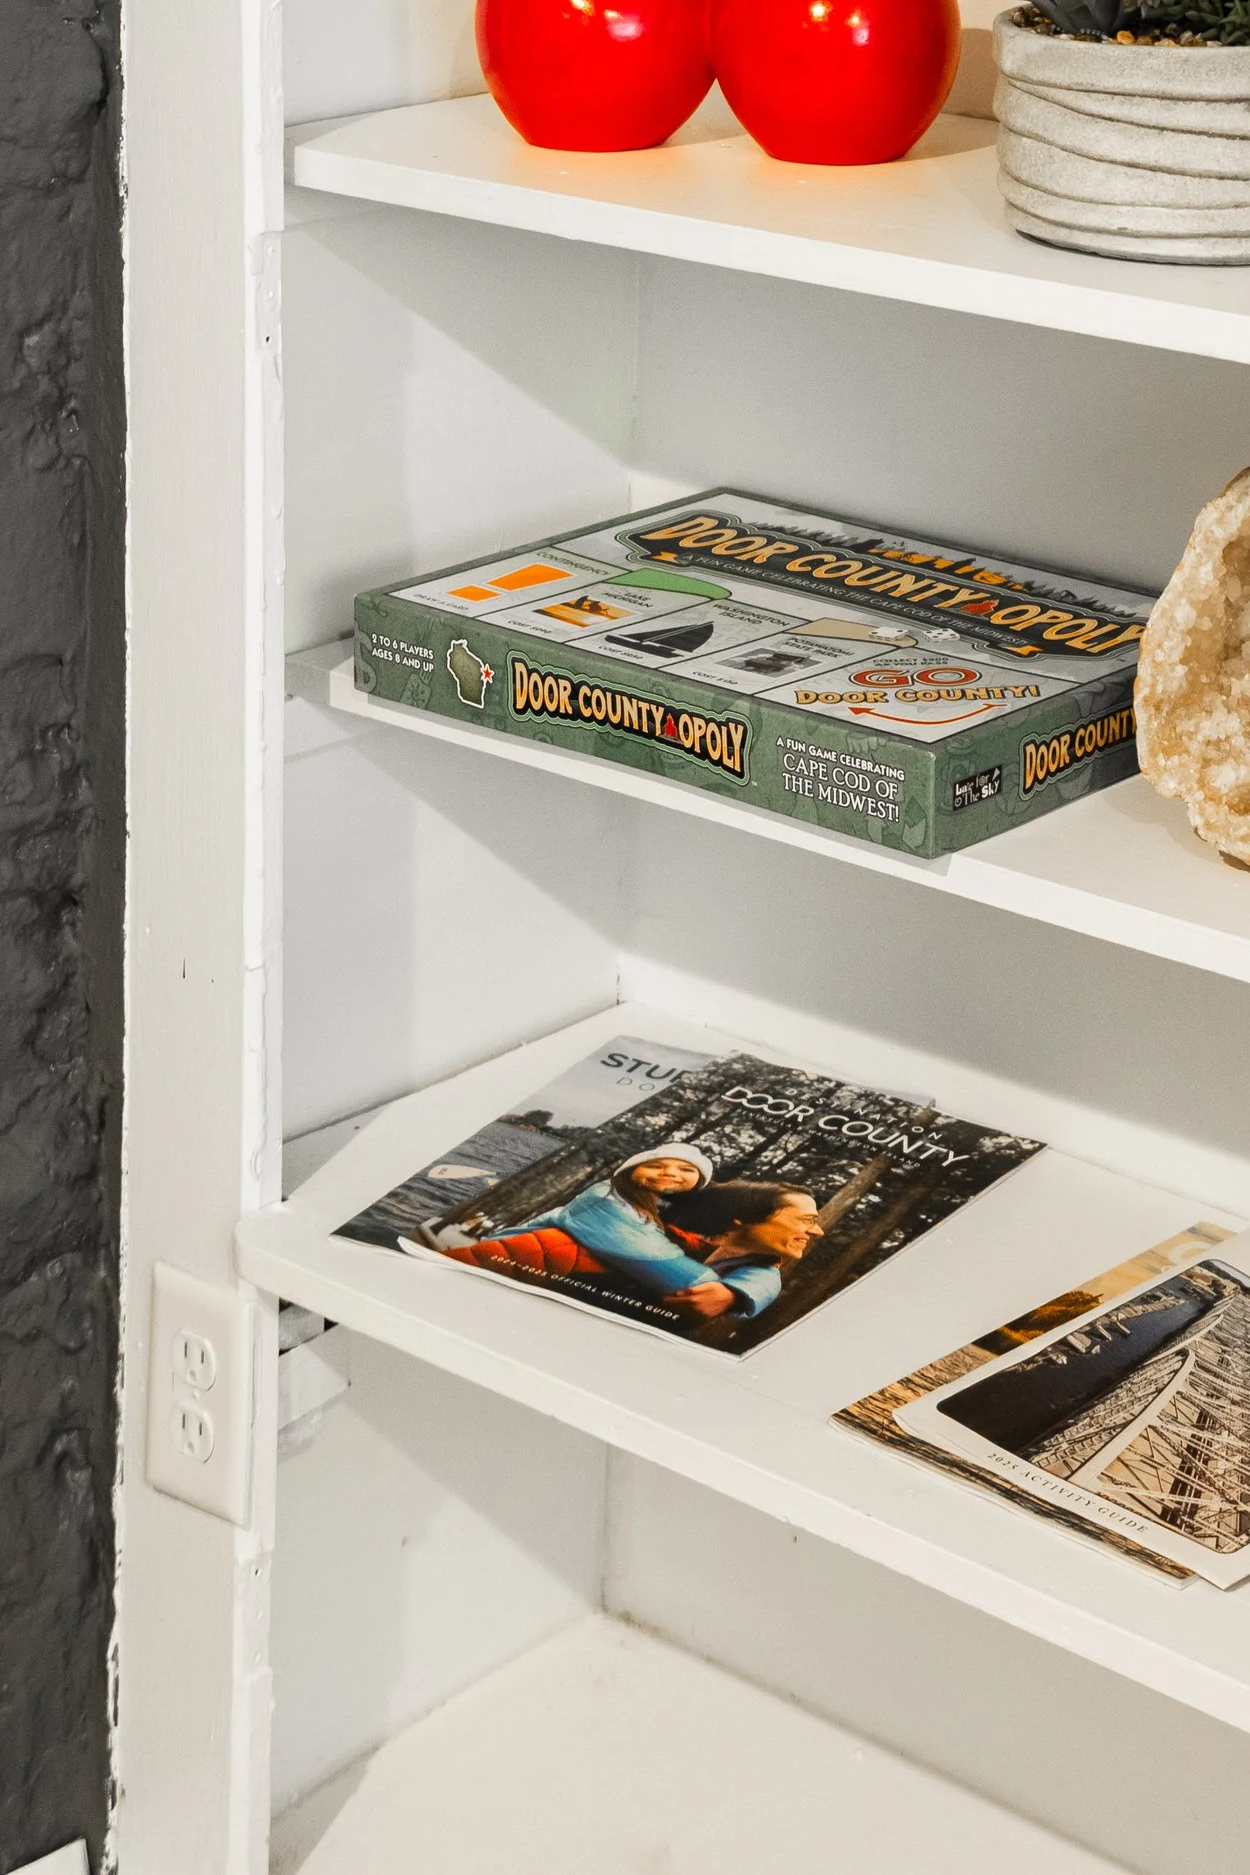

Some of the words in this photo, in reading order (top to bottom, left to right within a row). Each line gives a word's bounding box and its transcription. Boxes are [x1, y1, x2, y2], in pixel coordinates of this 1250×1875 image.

[535, 551, 613, 576] CONTINGENCY
[601, 592, 654, 609] MICHIGAN
[624, 591, 651, 602] LAKE
[639, 516, 800, 564] DOOR
[785, 553, 991, 610] COUNTY
[989, 603, 1147, 654] OPOLY
[694, 556, 728, 568] FUN
[726, 563, 766, 576] GAME
[761, 571, 847, 595] CELEBRATING
[845, 591, 872, 602] THE
[870, 598, 904, 611] CAPE
[903, 607, 932, 618] COD
[713, 602, 791, 627] WASHINGTON
[718, 611, 763, 625] ISLAND
[371, 633, 378, 644] 2
[378, 636, 391, 649] TO
[392, 639, 398, 650] 6
[400, 641, 434, 660] PLAYERS
[371, 647, 393, 662] AGES
[394, 653, 401, 664] 8
[402, 656, 421, 670] AND
[422, 661, 434, 673] UP
[783, 640, 815, 653] STATE
[814, 647, 840, 658] PARK
[793, 688, 889, 705] DOOR
[894, 684, 1041, 703] COUNTY!
[849, 666, 982, 689] GO
[514, 661, 573, 715] DOOR
[578, 685, 665, 737] COUNTY
[678, 712, 744, 772] OPOLY
[776, 736, 785, 747] A
[786, 738, 806, 753] FUN
[808, 745, 838, 763] GAME
[839, 754, 905, 781] CELEBRATING
[783, 753, 828, 781] CAPE
[832, 767, 871, 792] COD
[875, 779, 899, 800] OF
[1024, 733, 1071, 790] DOOR
[782, 772, 814, 798] THE
[817, 783, 900, 823] MIDWEST!
[721, 1085, 815, 1123] DOOR
[818, 1113, 970, 1168] COUNTY
[784, 1087, 944, 1142] DESTINATION
[881, 1150, 922, 1169] ISLAND
[550, 1273, 599, 1294] OFFICIAL
[601, 1289, 643, 1309] WINTER
[645, 1303, 681, 1322] GUIDE
[986, 1452, 1018, 1471] 2025
[1019, 1469, 1096, 1508] ACTIVITY
[1097, 1506, 1150, 1533] GUIDE
